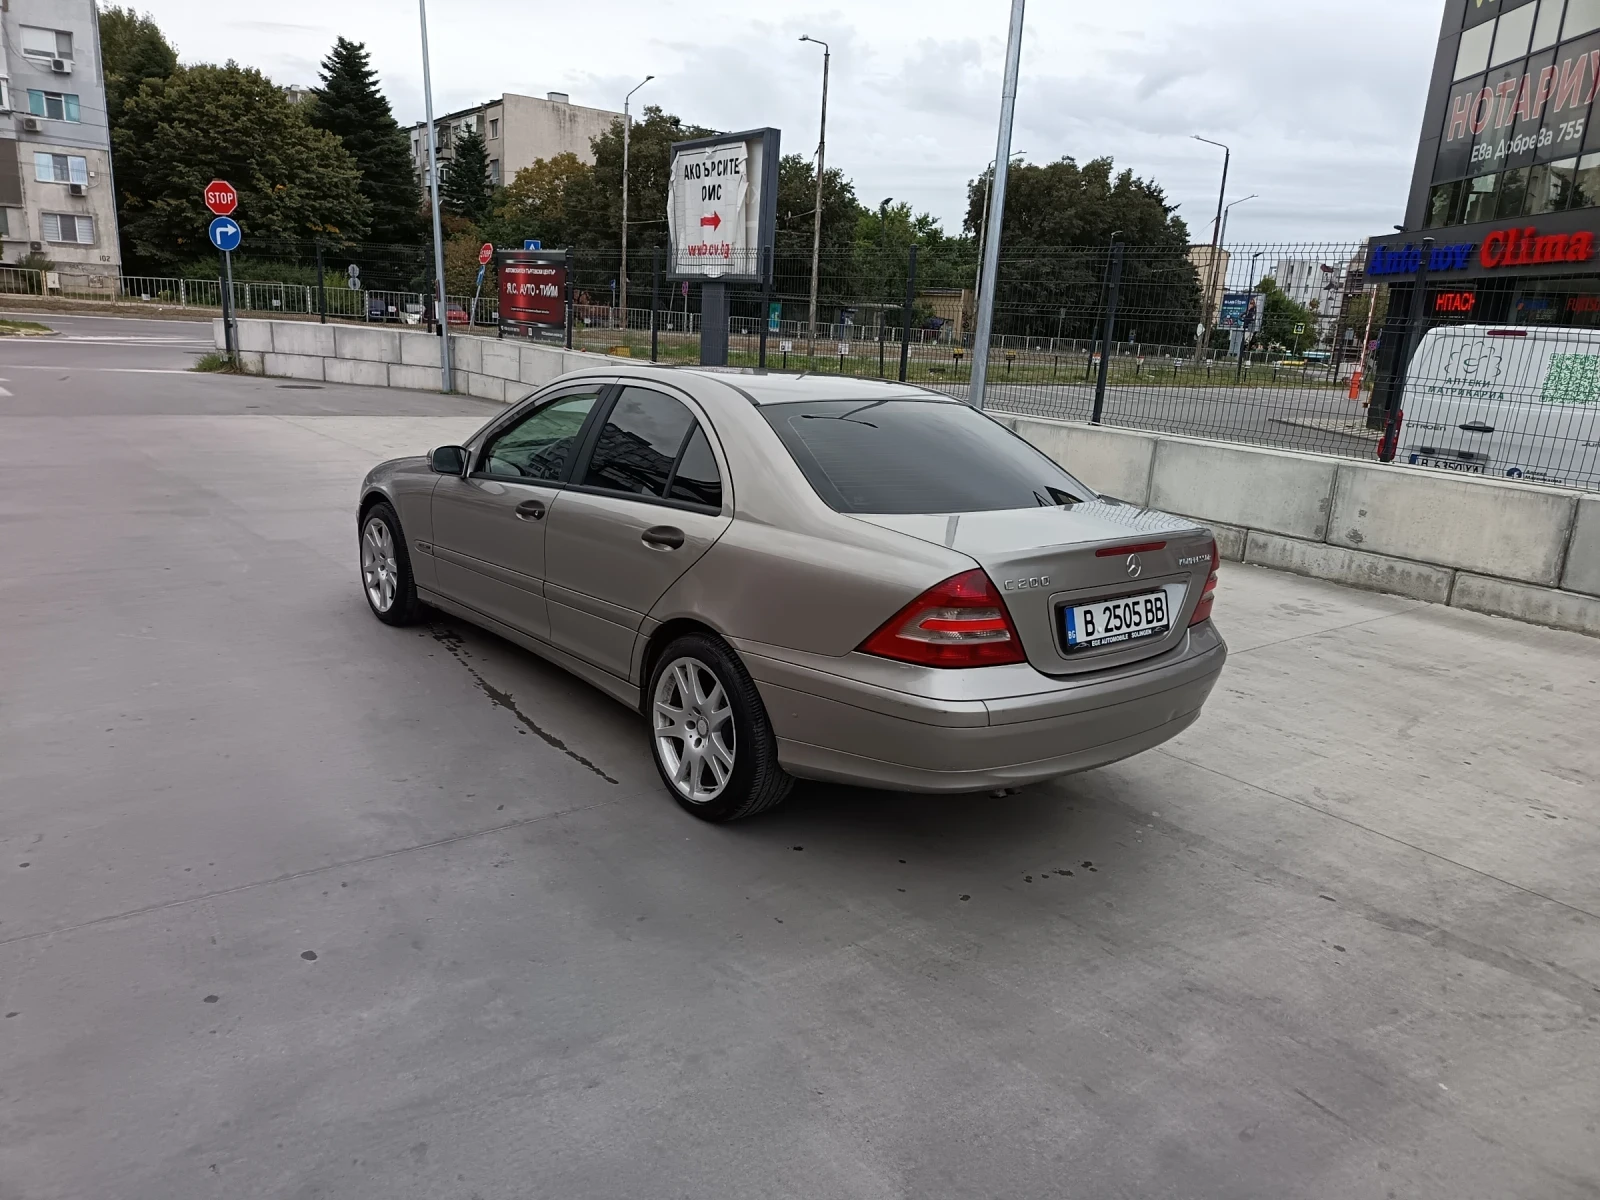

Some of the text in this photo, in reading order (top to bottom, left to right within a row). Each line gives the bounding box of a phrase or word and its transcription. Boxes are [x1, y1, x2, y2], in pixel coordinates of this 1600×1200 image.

[1557, 118, 1585, 142] 755
[208, 192, 233, 204] STOP
[1480, 227, 1594, 269] Clima
[1446, 377, 1490, 388] АПТЕКИ
[1004, 575, 1050, 590] C 200
[1083, 597, 1164, 637] B 2505 BB
[1067, 630, 1076, 639] BG
[1101, 633, 1129, 645] AUTOMOBILE
